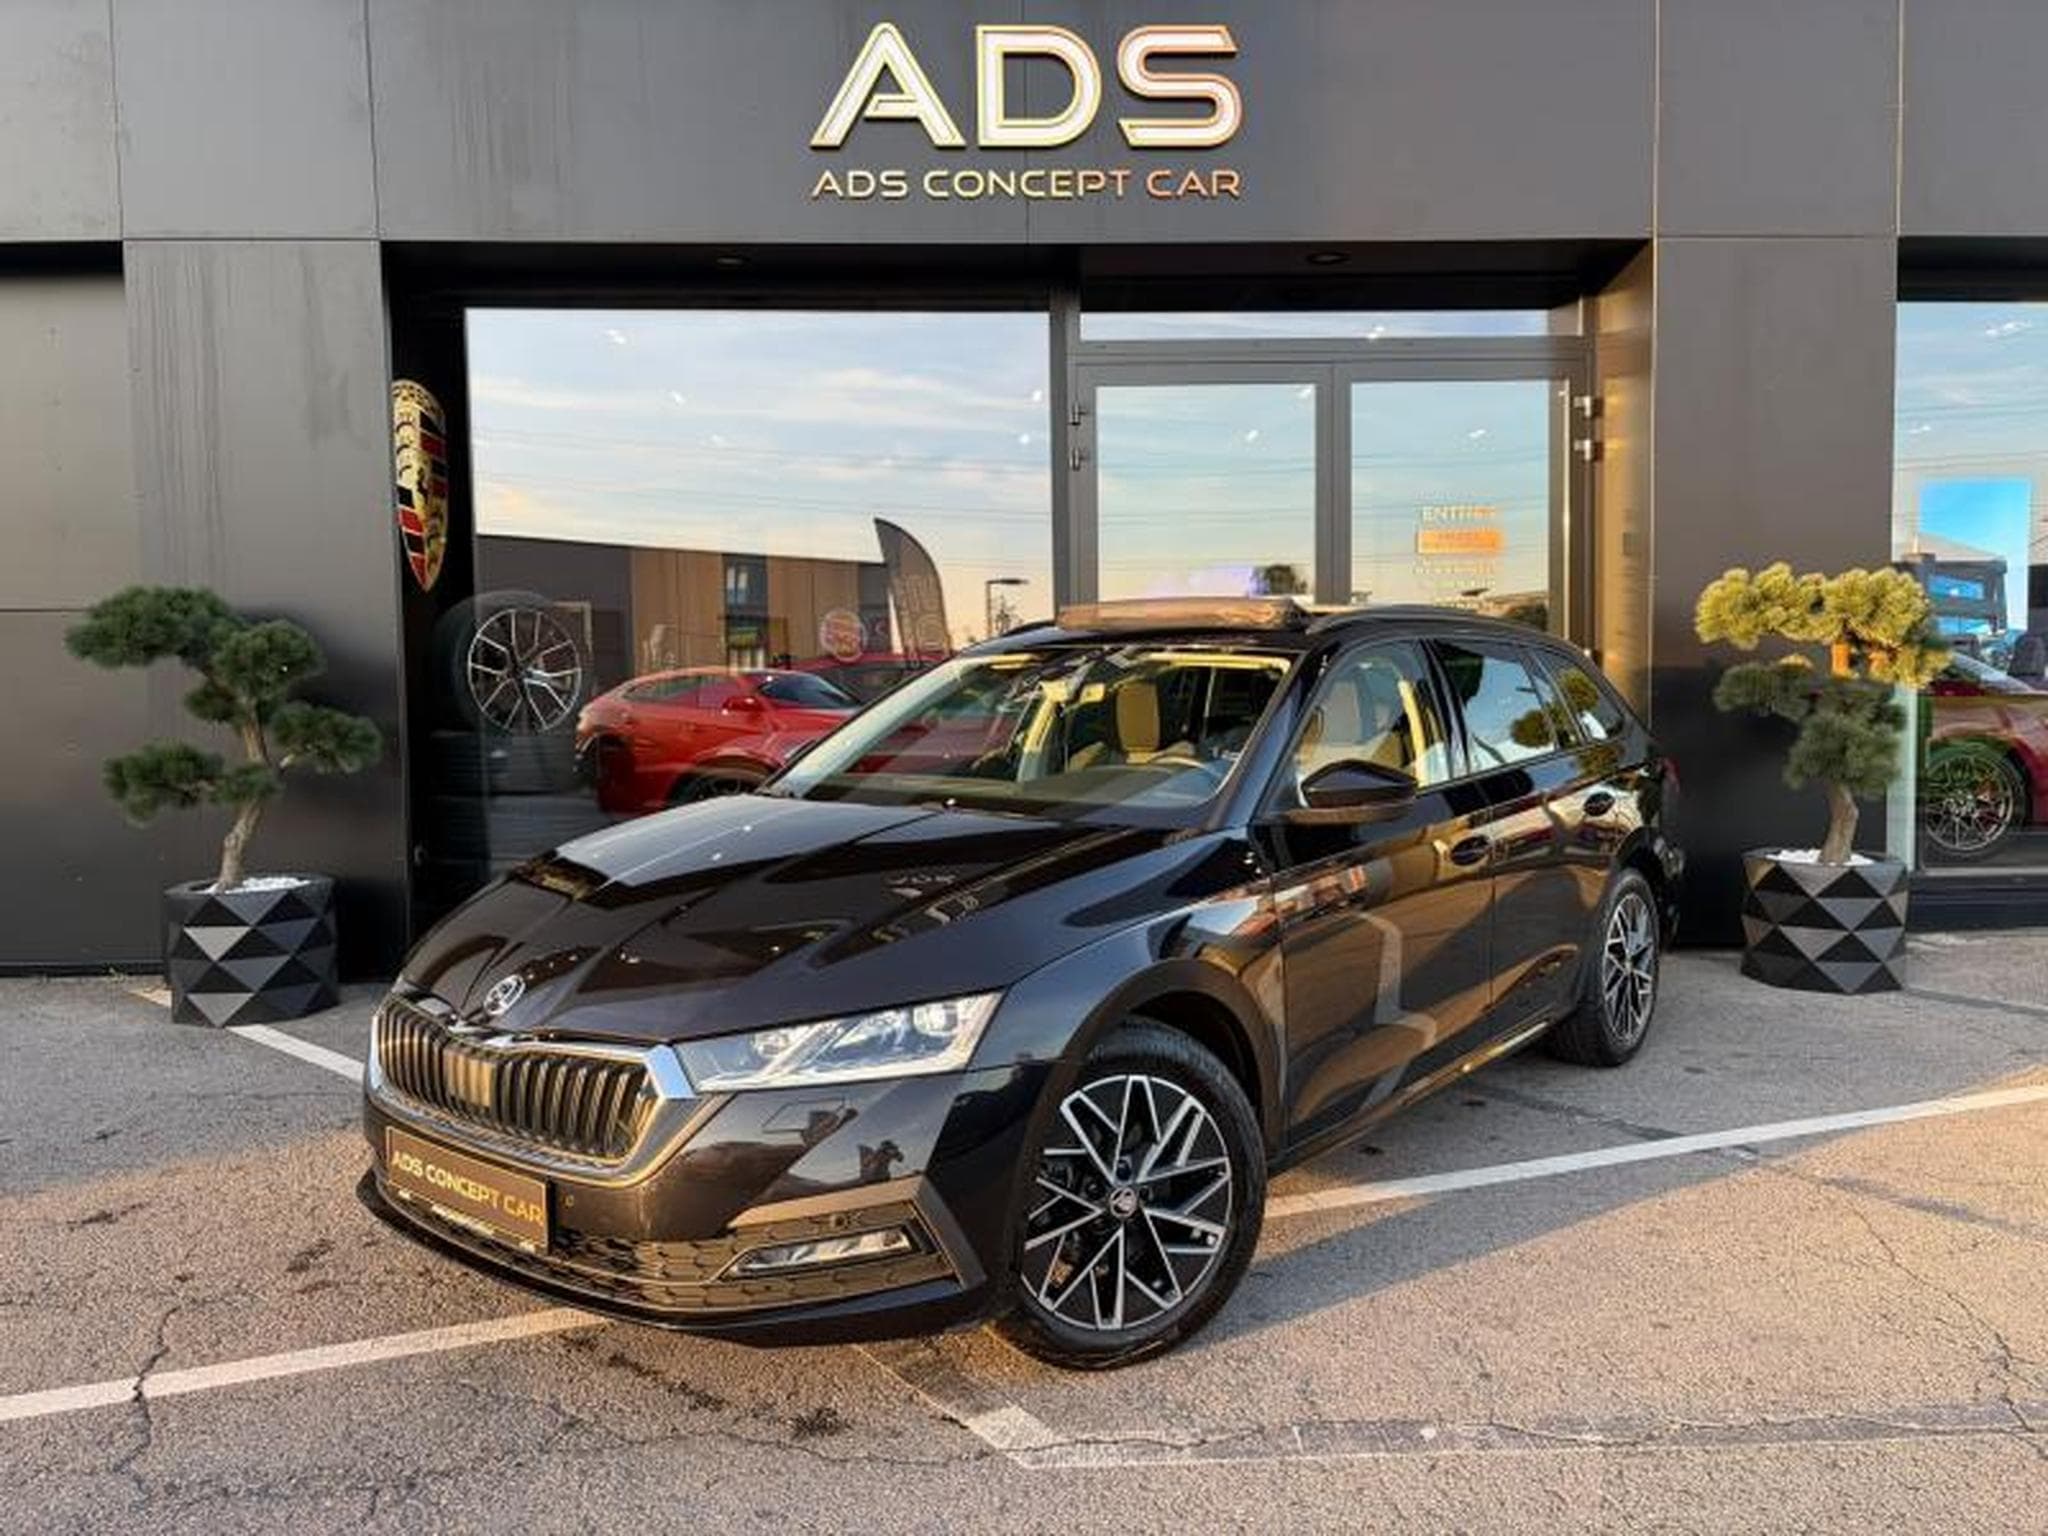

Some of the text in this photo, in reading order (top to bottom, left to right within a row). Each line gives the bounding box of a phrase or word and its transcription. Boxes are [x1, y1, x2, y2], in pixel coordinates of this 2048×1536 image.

[810, 22, 1242, 148] ADS
[811, 169, 1241, 198] ADS CONCEPT CAR
[391, 1149, 544, 1226] ADS CONCEPT CAR
